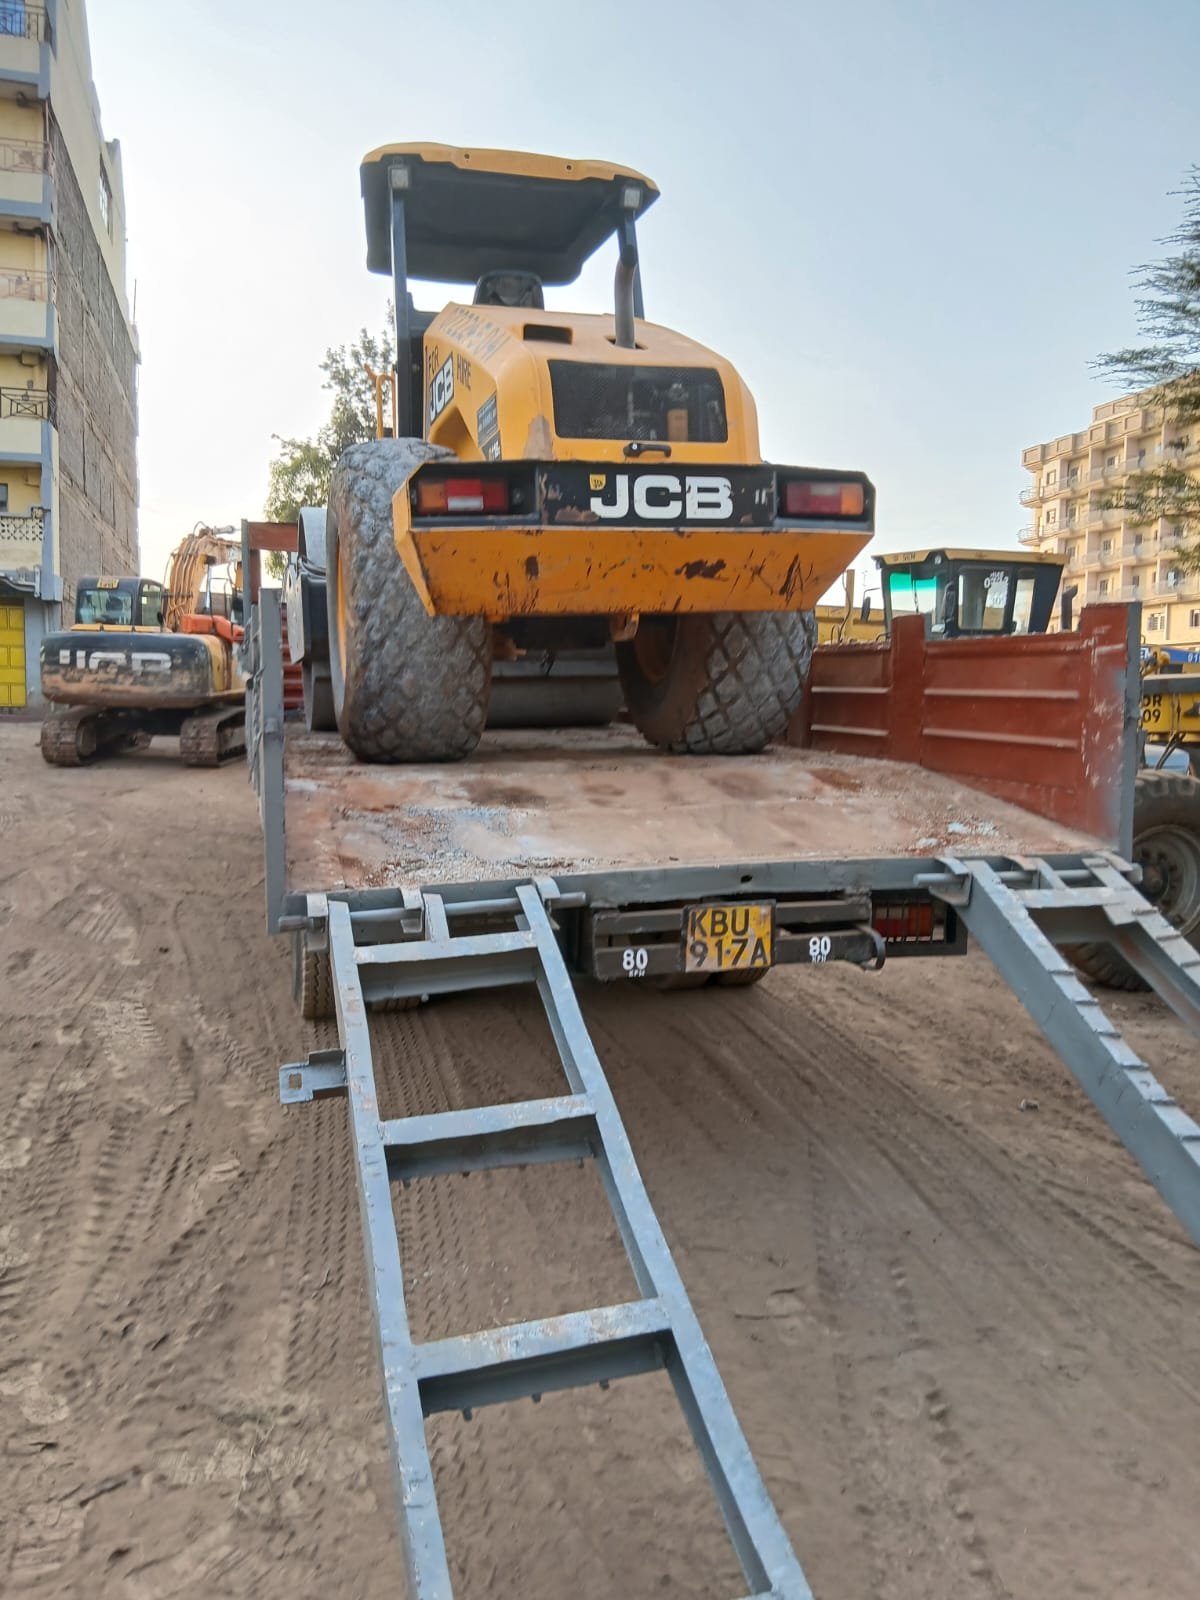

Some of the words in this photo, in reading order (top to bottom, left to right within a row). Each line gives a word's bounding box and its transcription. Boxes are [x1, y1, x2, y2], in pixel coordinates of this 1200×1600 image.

[430, 356, 454, 422] JCB
[590, 474, 733, 519] JCB
[691, 908, 749, 938] KBU
[622, 948, 648, 970] 80
[690, 938, 768, 967] 917A
[809, 935, 831, 956] 80
